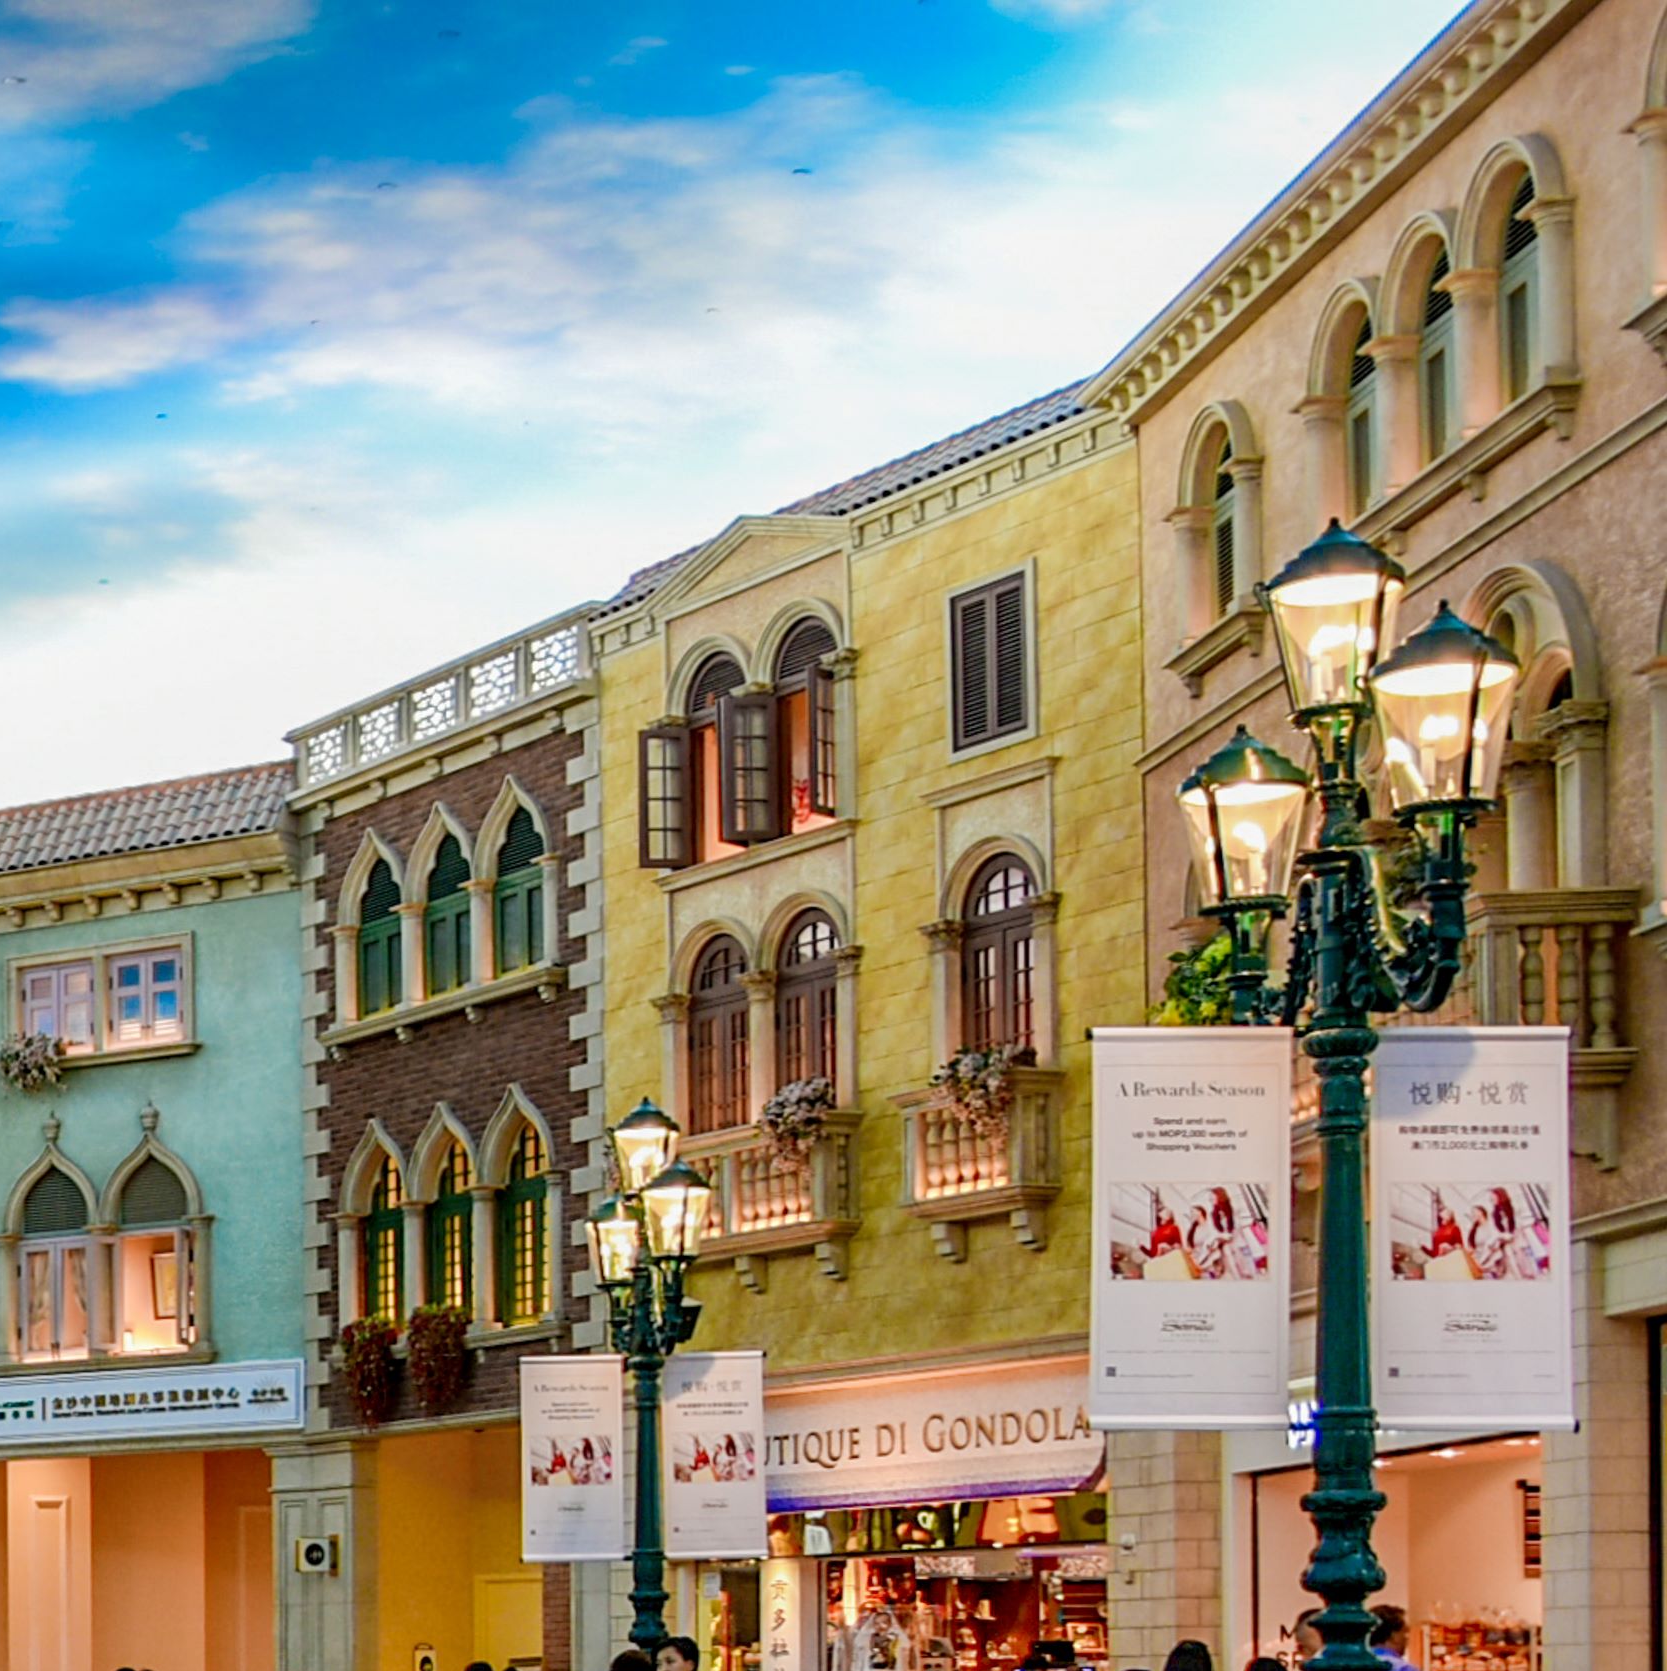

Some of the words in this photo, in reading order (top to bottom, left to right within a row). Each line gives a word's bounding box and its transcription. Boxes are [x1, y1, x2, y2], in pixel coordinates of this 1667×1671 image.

[1117, 1082, 1128, 1097] A
[1133, 1081, 1204, 1097] Rewards
[1208, 1082, 1266, 1097] Season
[1185, 1117, 1203, 1125] and
[1146, 1142, 1190, 1152] Shopping
[1193, 1142, 1237, 1151] Vouchers
[875, 1421, 907, 1458] DI
[923, 1405, 1092, 1453] GONDOLA
